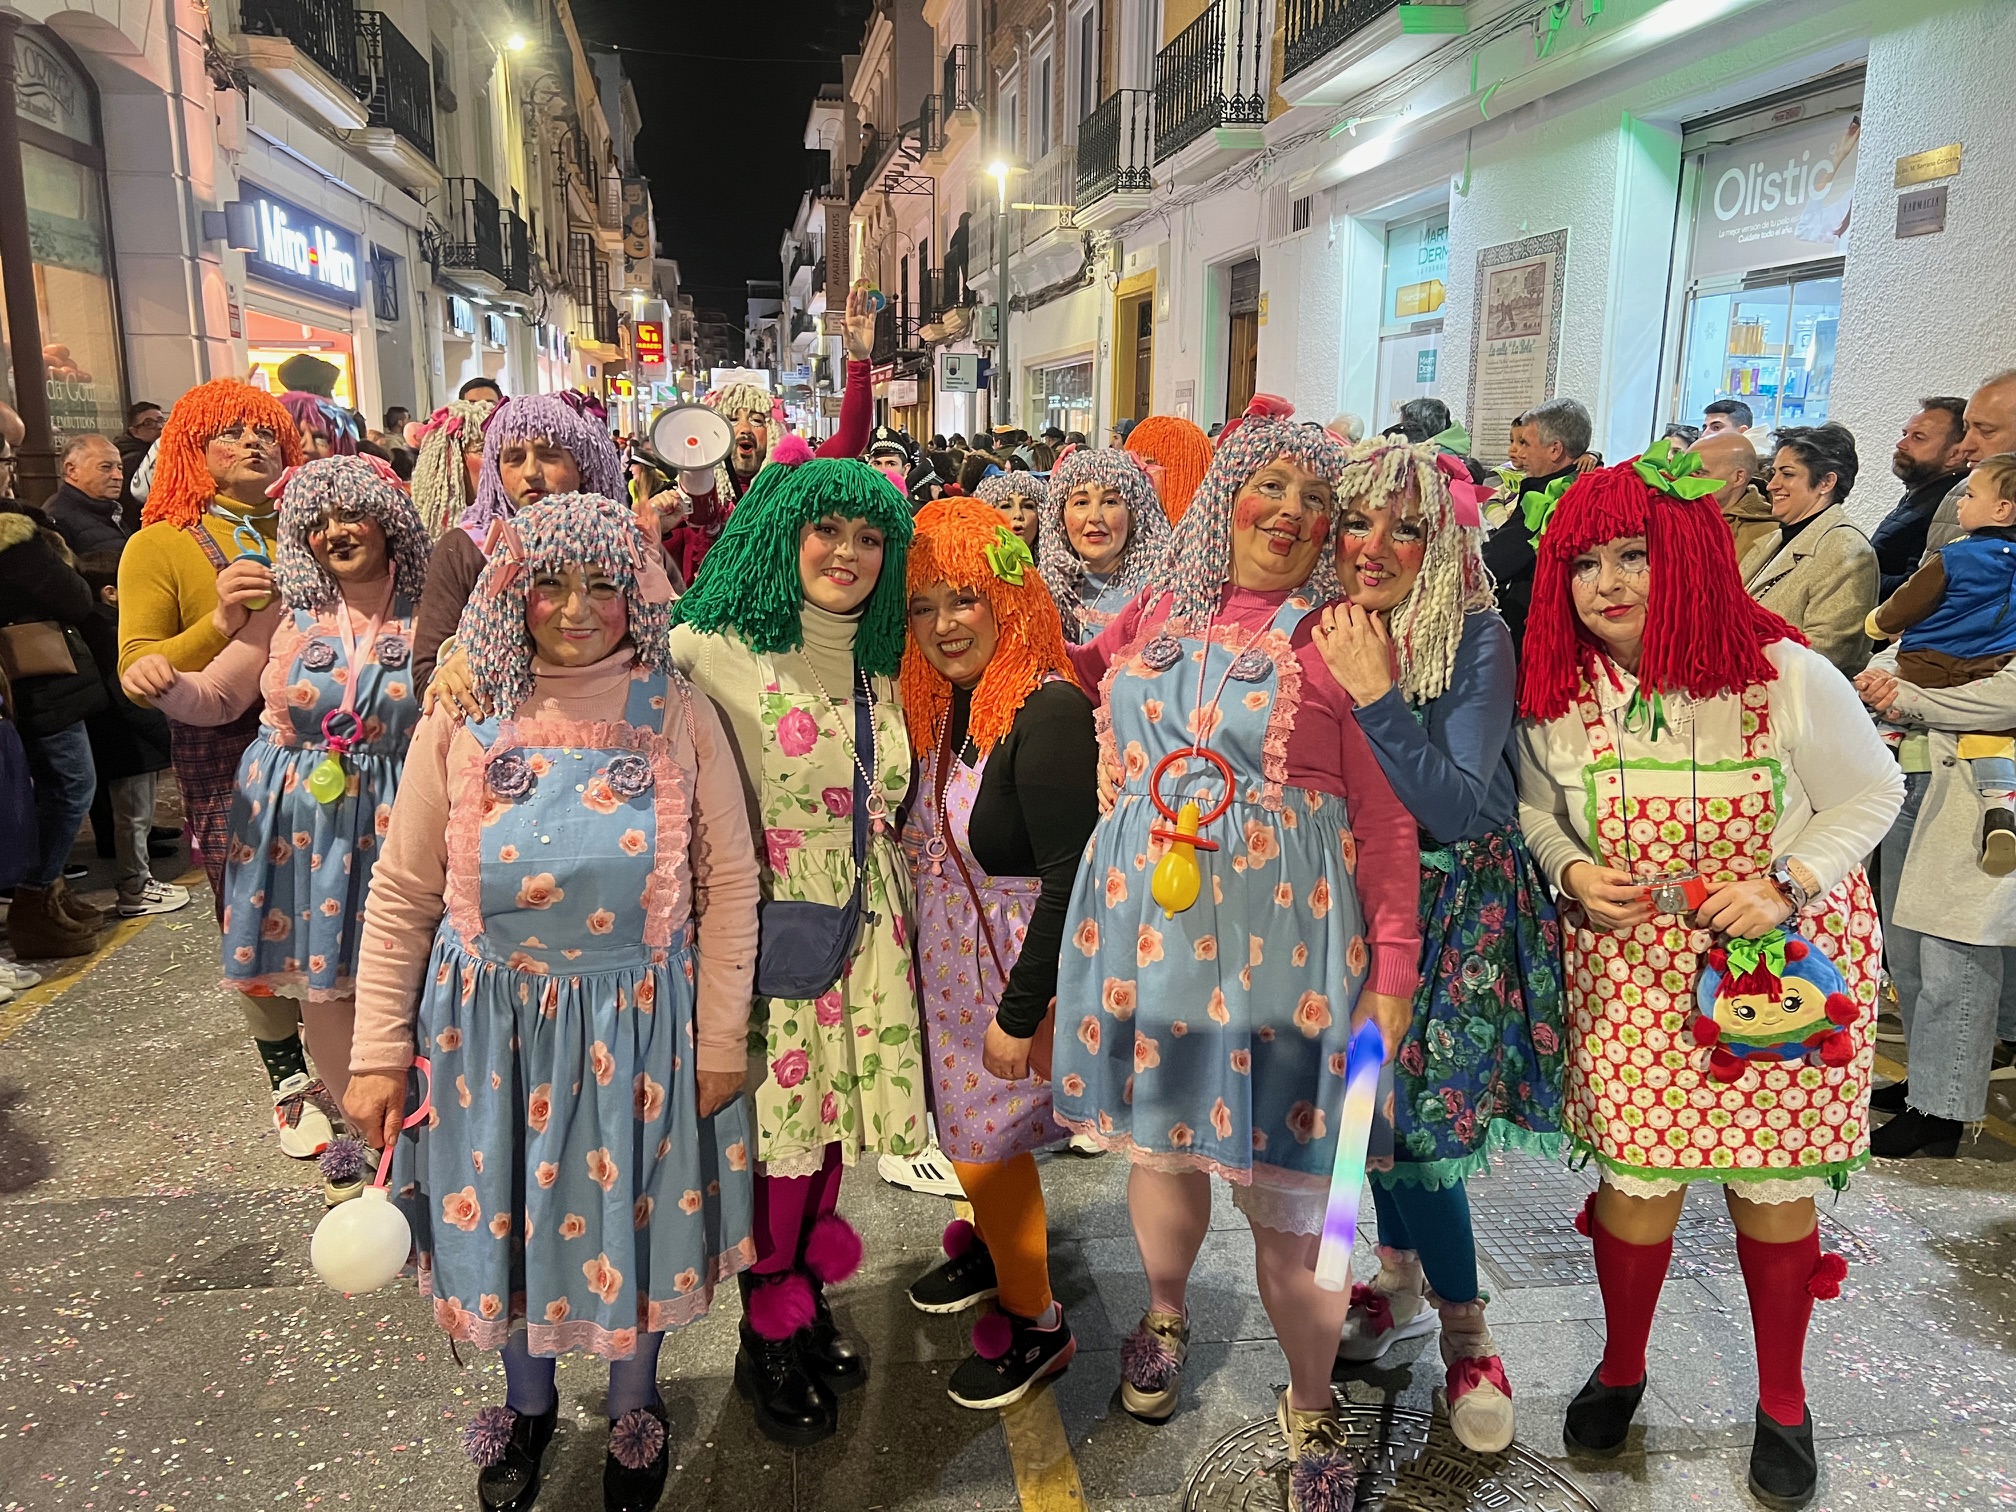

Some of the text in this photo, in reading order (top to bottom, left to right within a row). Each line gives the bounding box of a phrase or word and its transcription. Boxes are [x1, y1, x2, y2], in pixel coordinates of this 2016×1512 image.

[1713, 150, 1835, 221] Olistic
[1903, 196, 1939, 214] FARMACIA
[259, 199, 356, 292] Mira Mira
[832, 213, 840, 286] APARTAMENTOS
[1718, 230, 1725, 238] La
[1726, 228, 1740, 236] mejor
[1762, 220, 1769, 229] de
[1770, 219, 1776, 227] tu
[1777, 216, 1790, 226] pelo
[1761, 229, 1775, 239] todo
[1775, 227, 1781, 235] el
